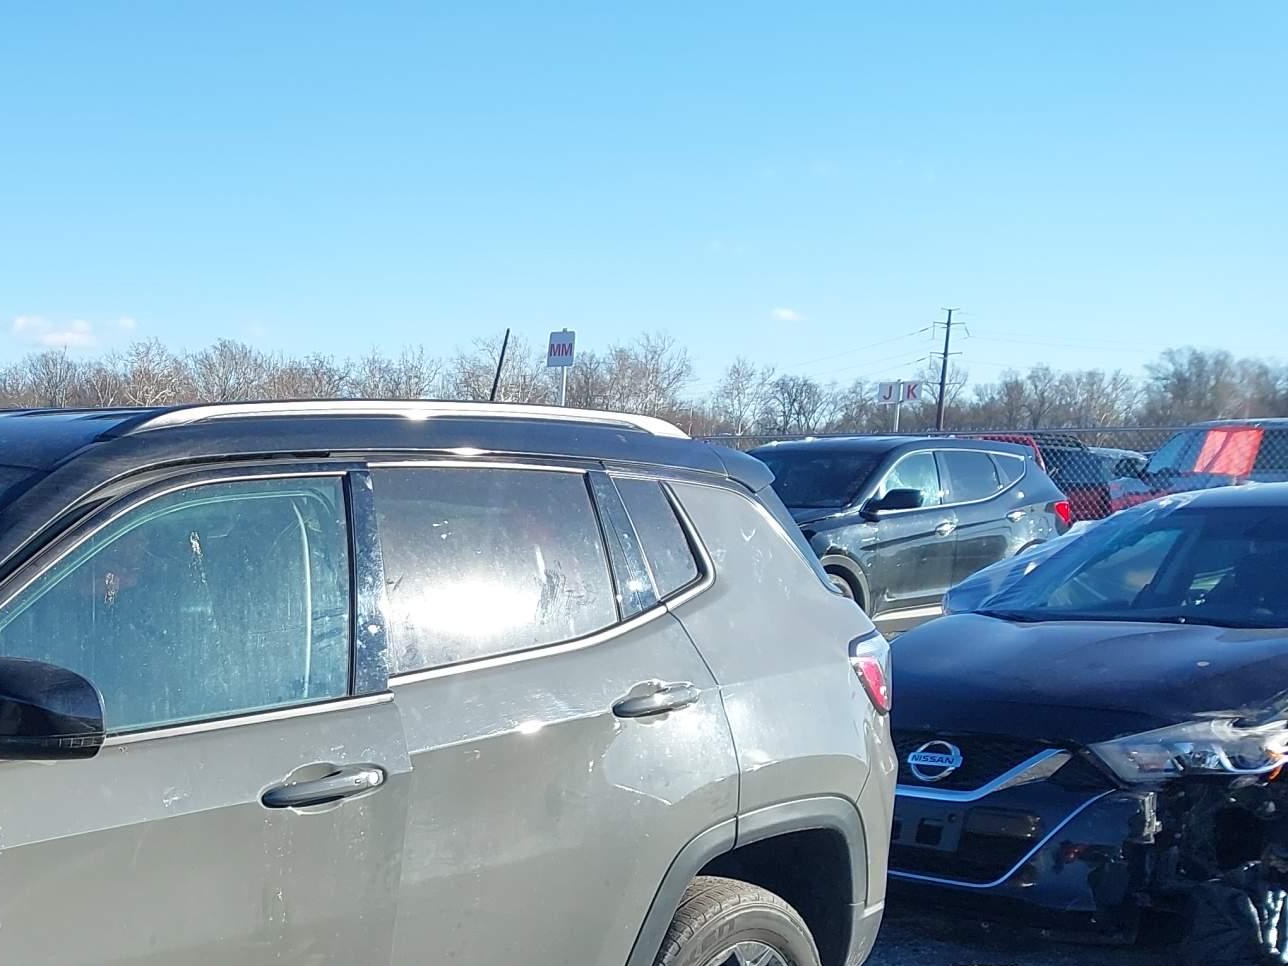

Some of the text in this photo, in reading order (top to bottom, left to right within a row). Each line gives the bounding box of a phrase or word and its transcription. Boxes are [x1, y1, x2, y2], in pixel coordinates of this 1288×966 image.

[549, 343, 573, 357] MM
[882, 383, 918, 400] J K
[911, 754, 955, 765] NISSAN
